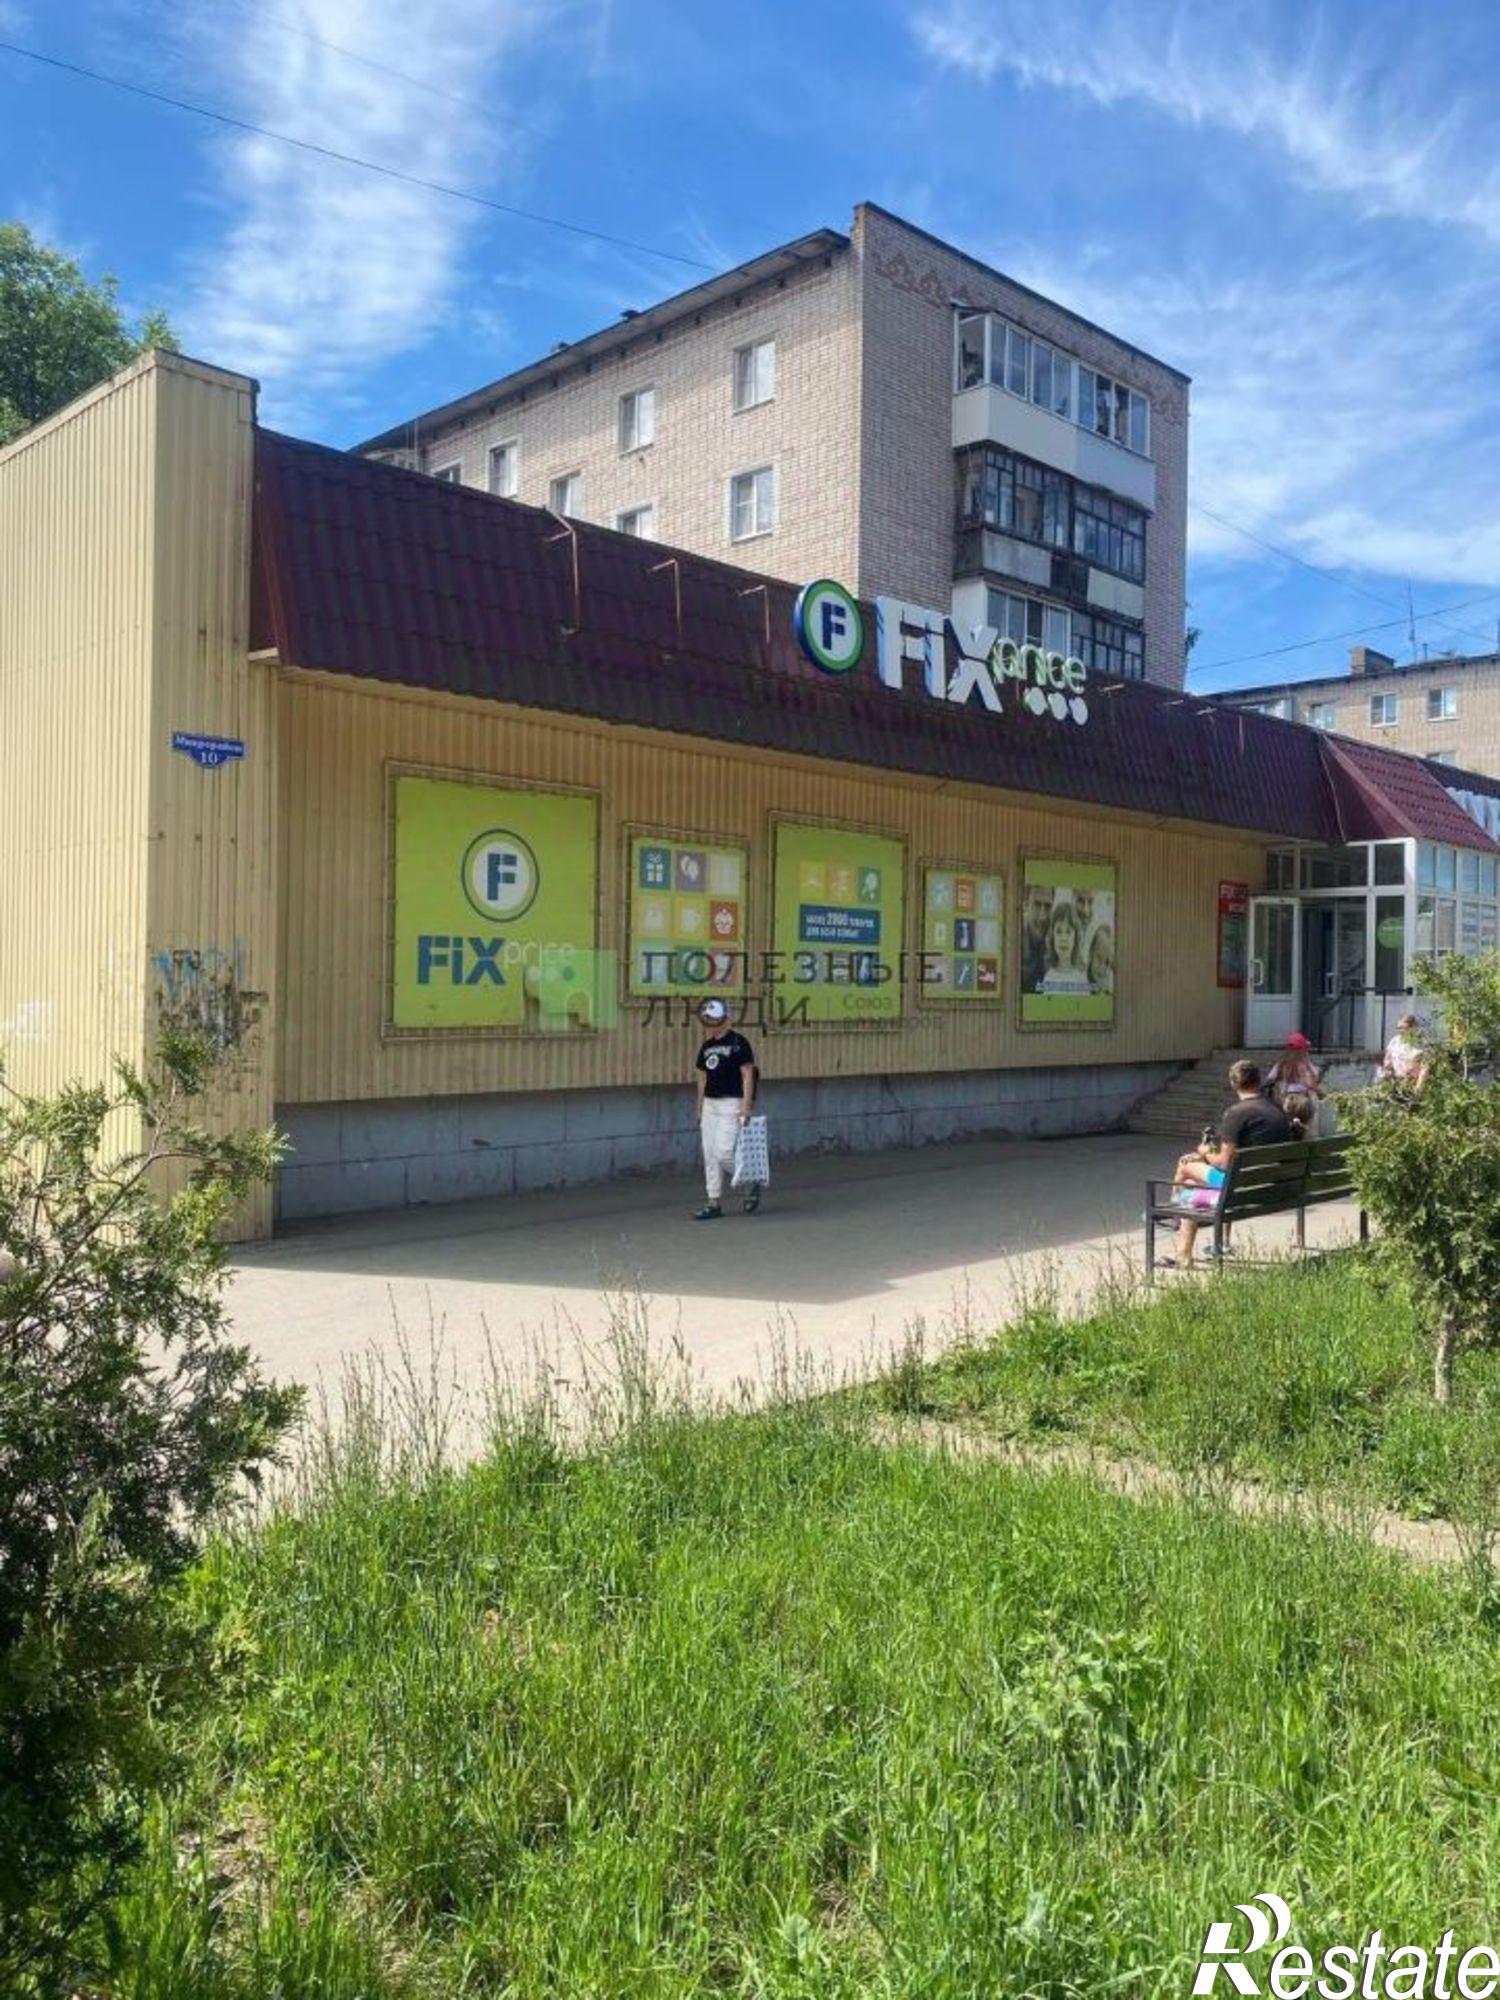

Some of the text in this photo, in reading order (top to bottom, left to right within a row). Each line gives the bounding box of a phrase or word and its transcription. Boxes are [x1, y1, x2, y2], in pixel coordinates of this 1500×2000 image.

[820, 601, 847, 651] F
[201, 751, 219, 765] 10
[486, 852, 518, 901] F
